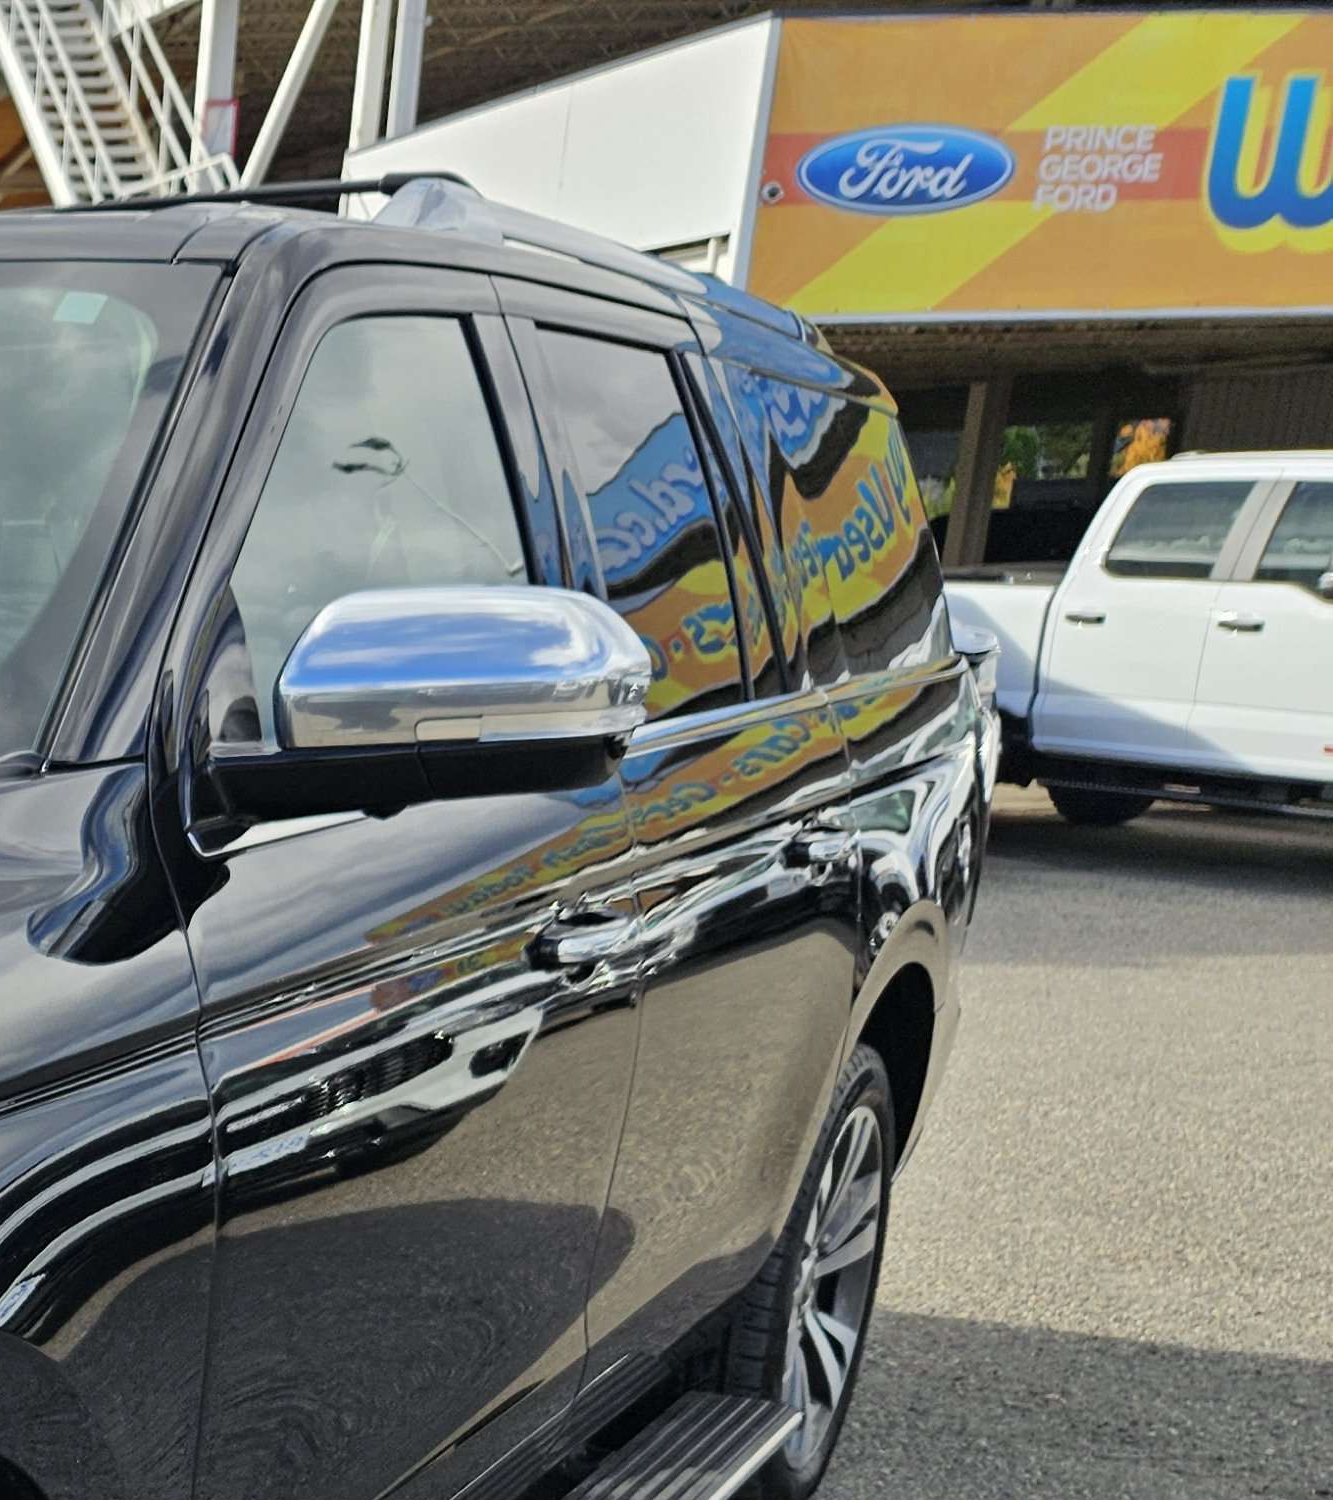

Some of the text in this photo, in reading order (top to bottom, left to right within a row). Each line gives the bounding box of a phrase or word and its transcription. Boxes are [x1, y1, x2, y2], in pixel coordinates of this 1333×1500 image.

[1044, 124, 1157, 151] PRINCE
[839, 137, 974, 201] Ford
[1039, 153, 1163, 182] GEORGE
[1031, 183, 1117, 213] FORD
